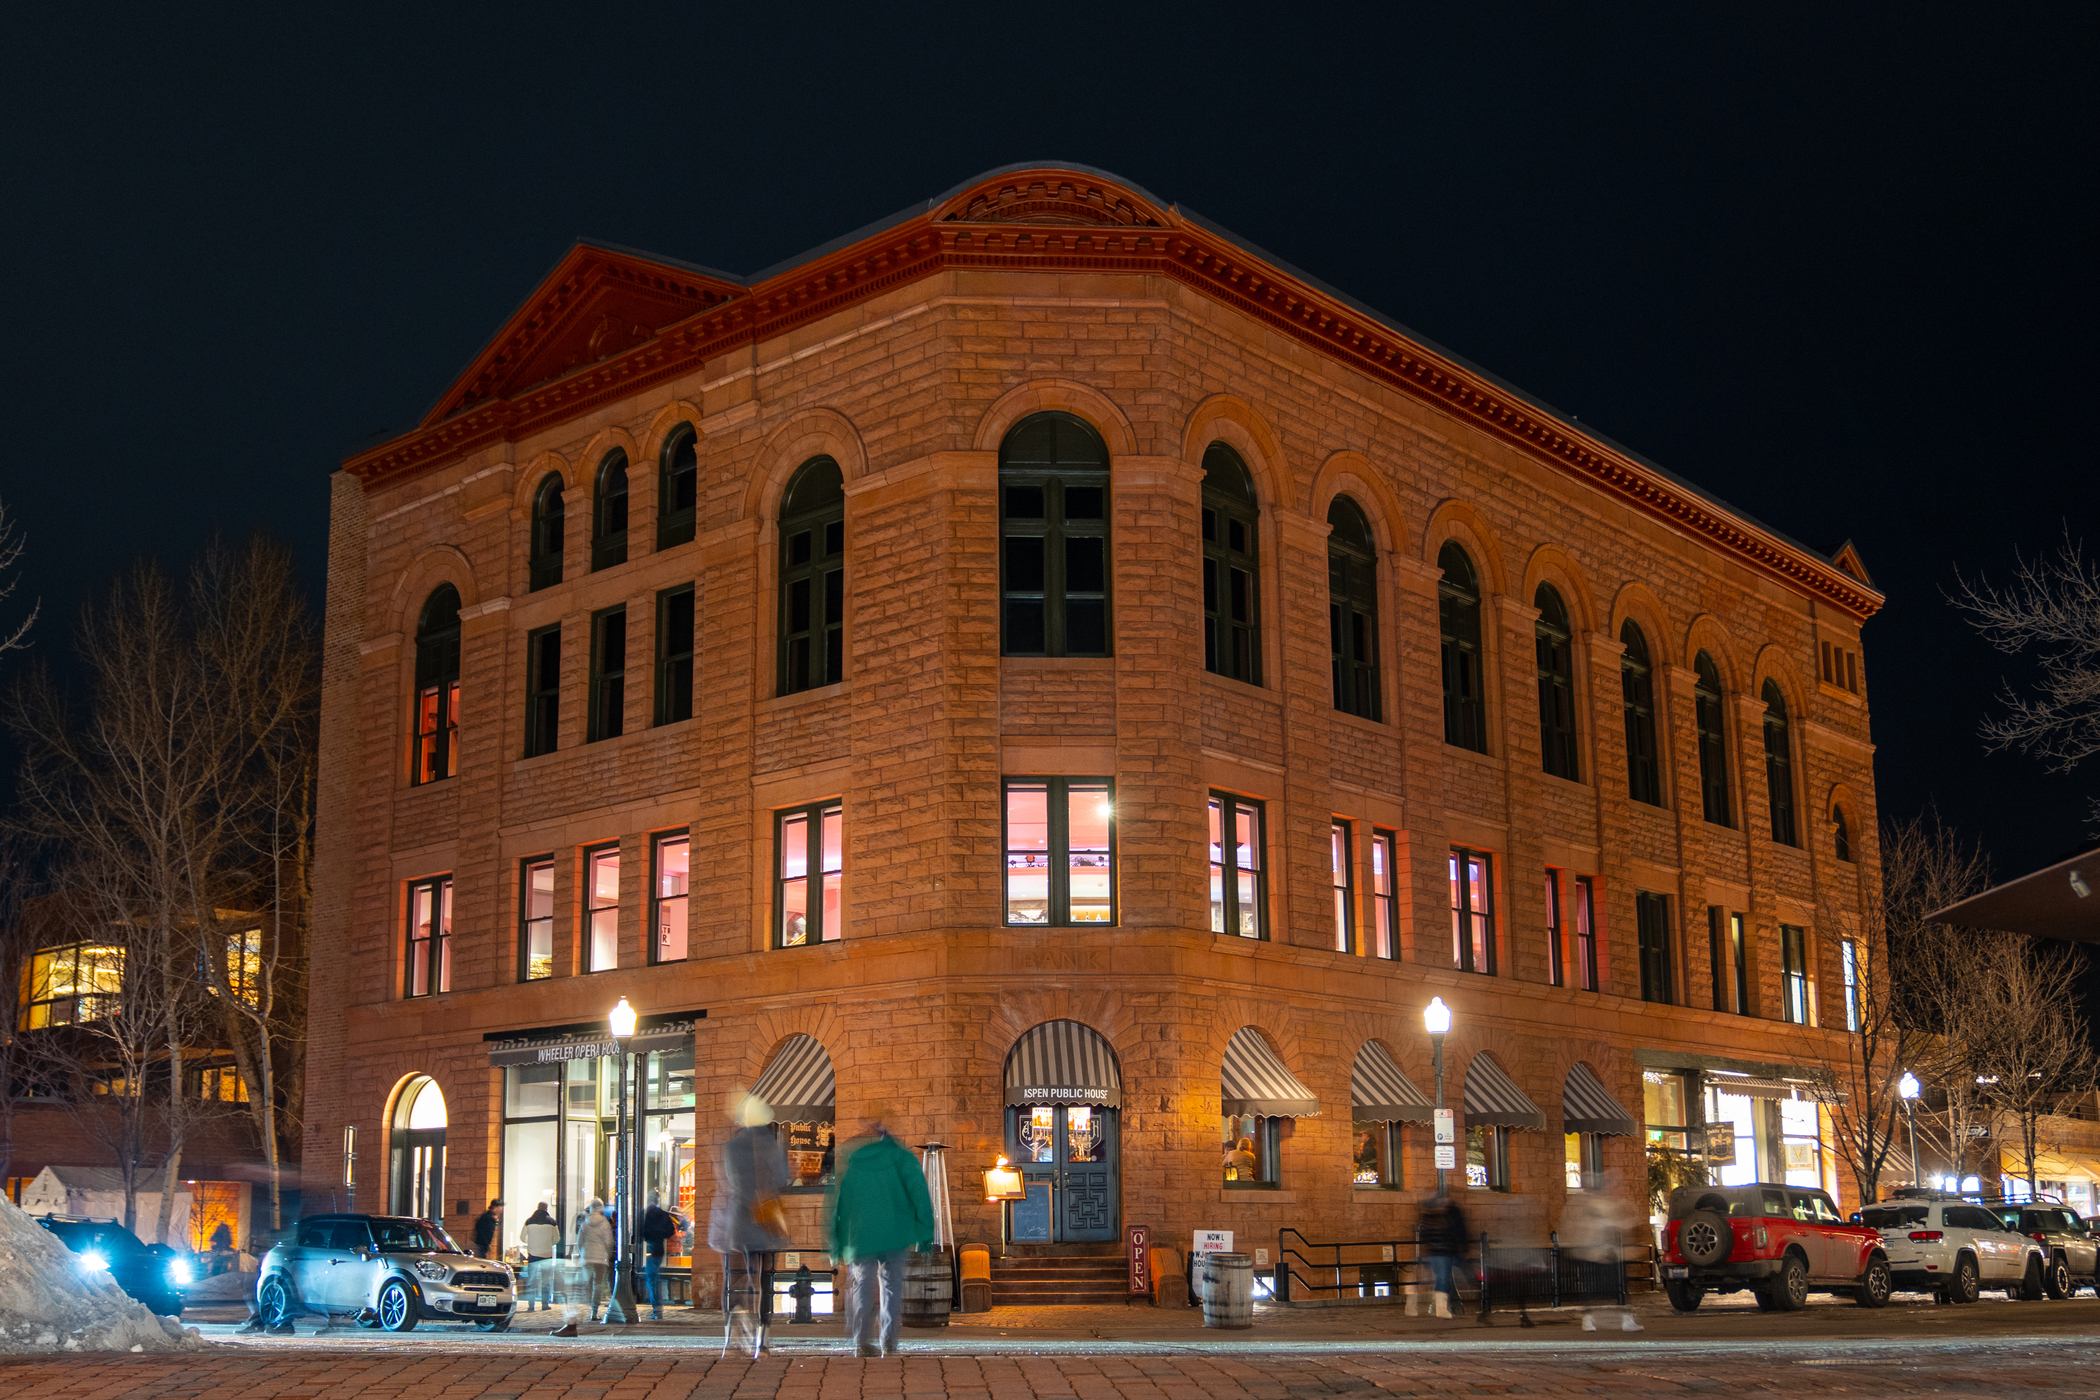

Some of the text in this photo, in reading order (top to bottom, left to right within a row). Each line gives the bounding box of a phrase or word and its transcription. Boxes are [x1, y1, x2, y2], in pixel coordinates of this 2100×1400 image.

[1022, 951, 1104, 970] BANK
[538, 1046, 574, 1061] WHEELER
[575, 1043, 600, 1057] OPERA
[1024, 1088, 1109, 1100] ASPEN PUBLIC HOUSE
[790, 1122, 812, 1133] Public
[790, 1135, 812, 1147] House
[1207, 1233, 1220, 1241] NOW
[1203, 1242, 1223, 1250] HIRING
[1133, 1233, 1144, 1289] OPEN
